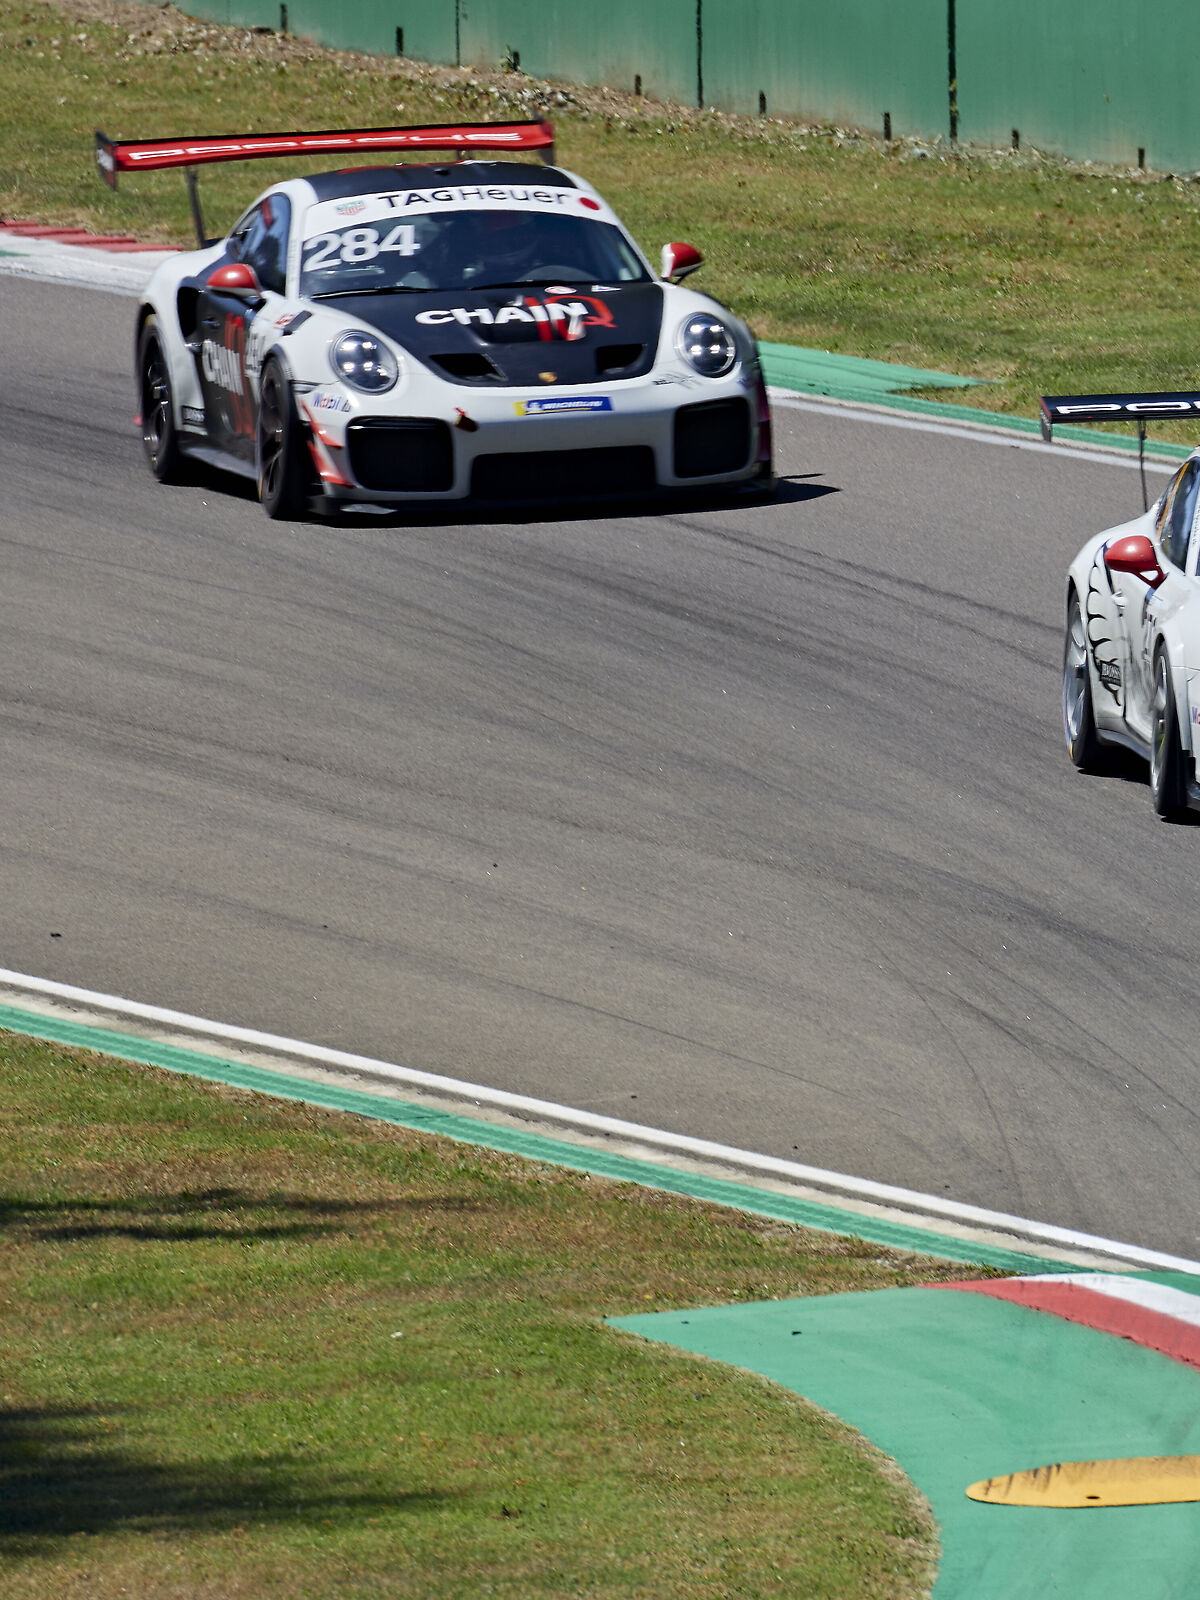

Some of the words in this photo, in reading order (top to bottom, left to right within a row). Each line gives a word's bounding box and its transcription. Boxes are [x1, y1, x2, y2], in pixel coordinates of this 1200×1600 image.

[128, 133, 523, 160] PORSCHE
[302, 225, 421, 273] 284
[415, 302, 589, 325] CHAIN
